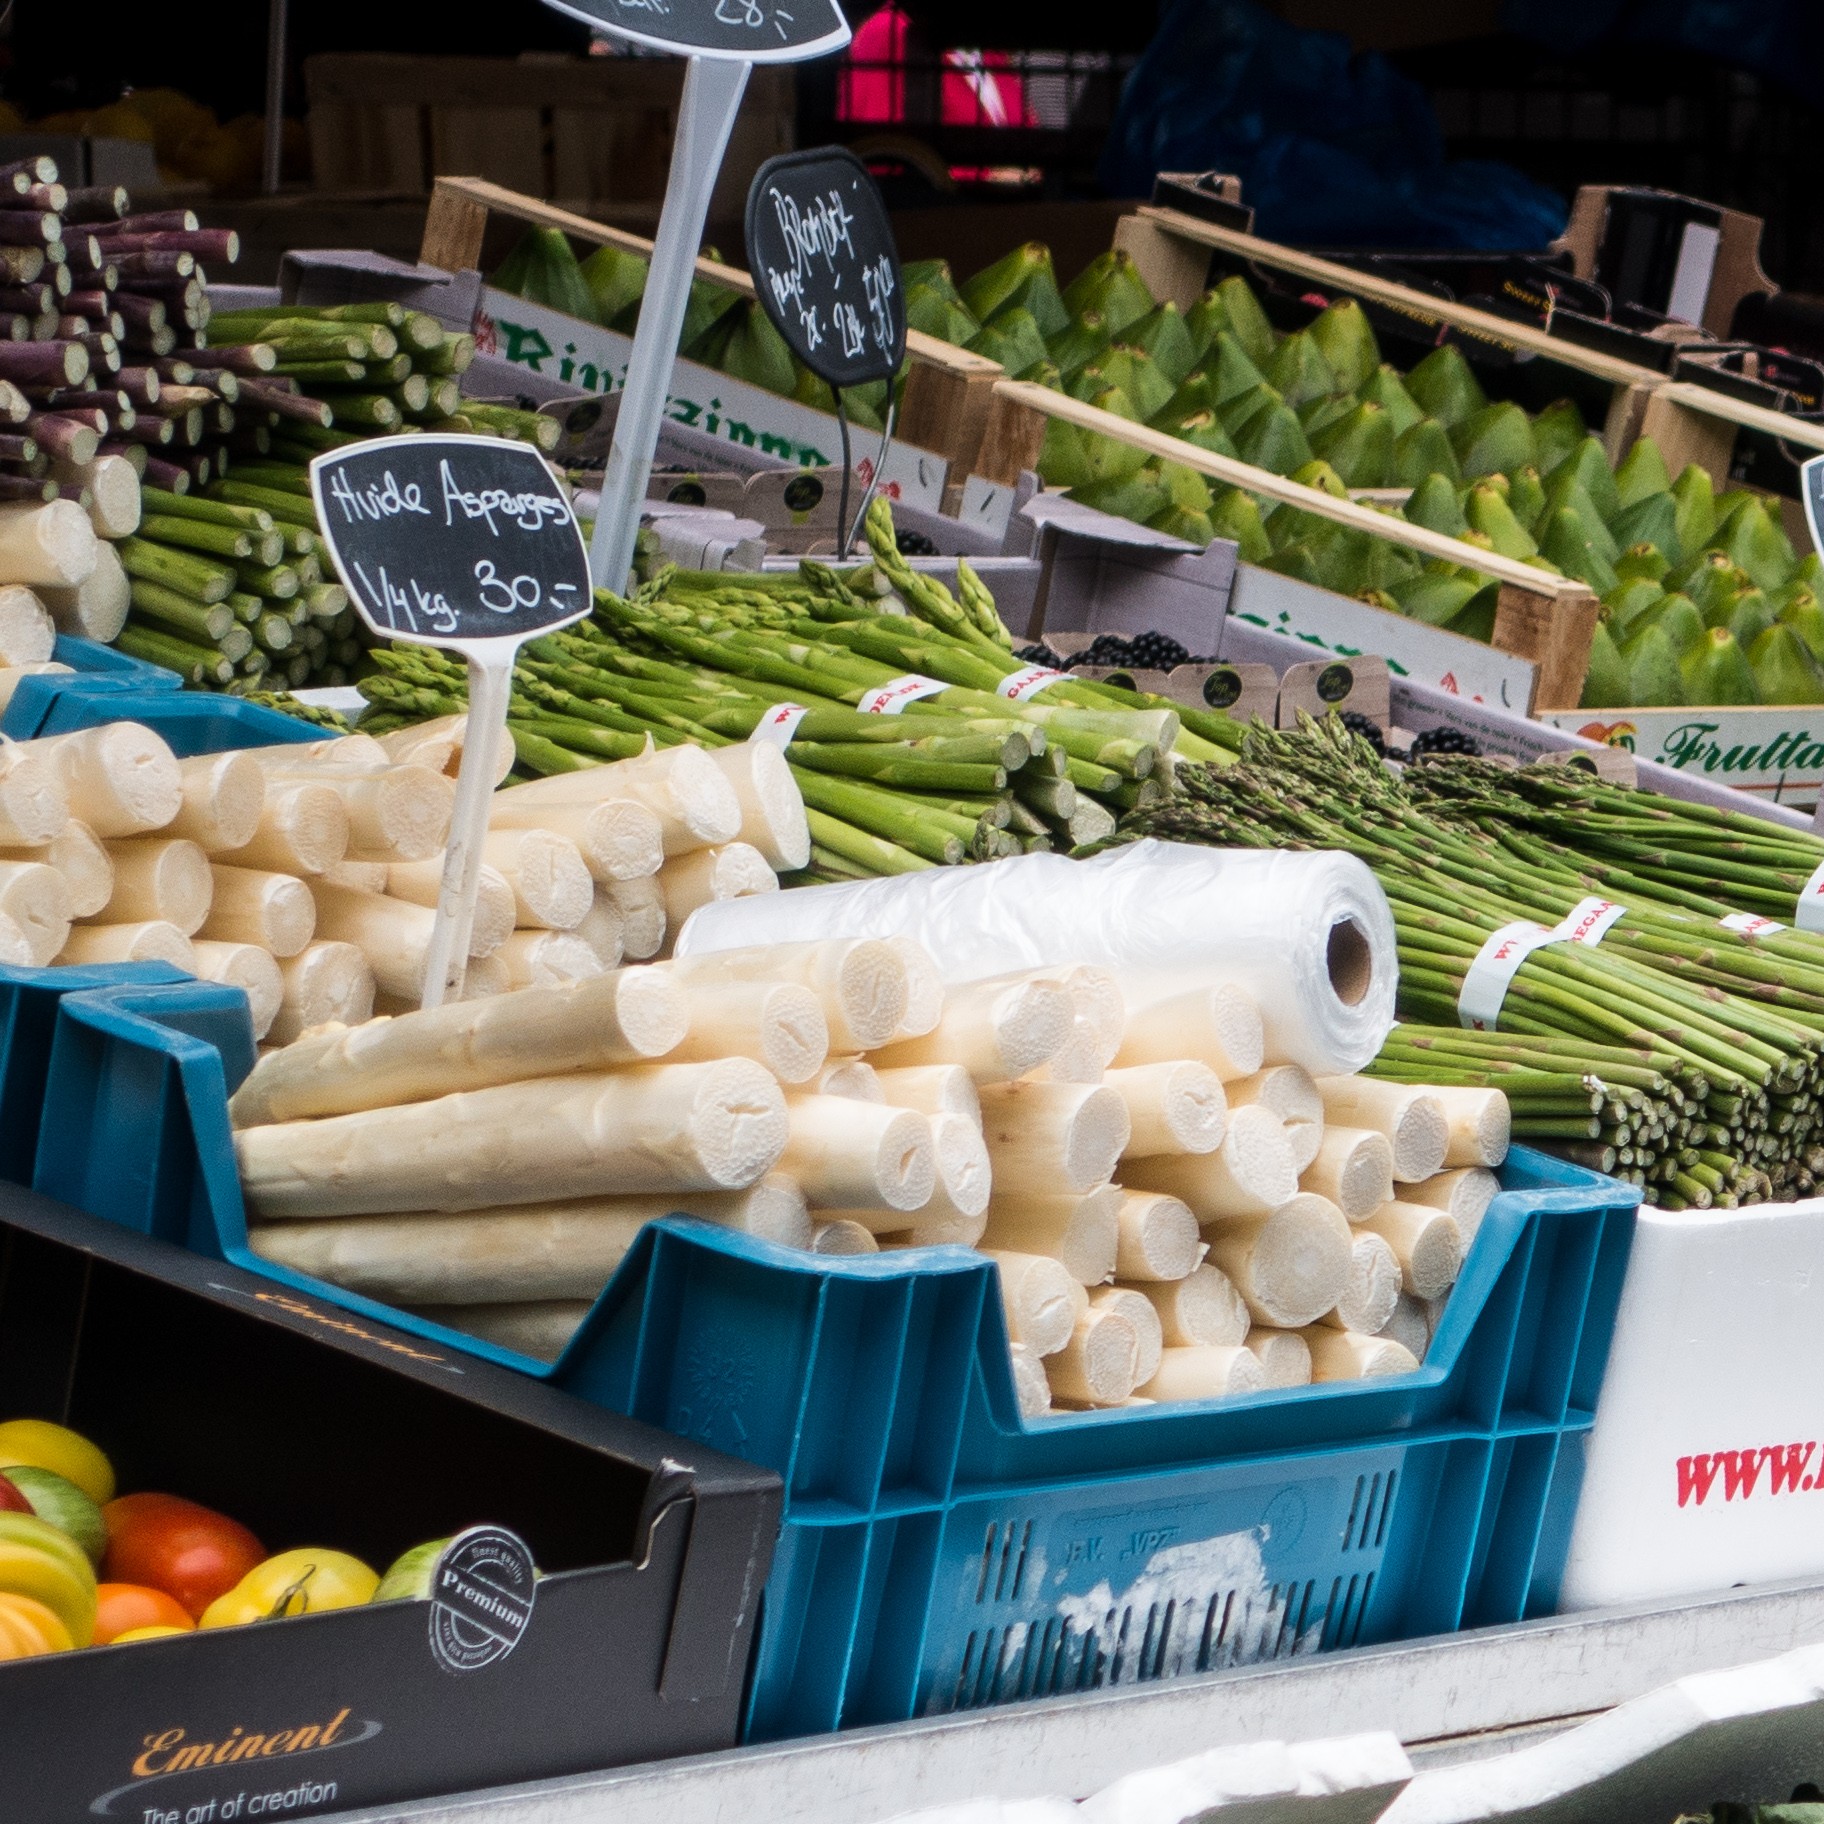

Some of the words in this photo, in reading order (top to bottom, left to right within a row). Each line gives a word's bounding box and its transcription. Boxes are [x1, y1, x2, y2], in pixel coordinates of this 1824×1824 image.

[331, 465, 432, 524] Hvide
[441, 1569, 525, 1629] Premium
[130, 1706, 352, 1779] Eminent
[220, 1792, 247, 1821] of
[247, 1780, 340, 1816] creation
